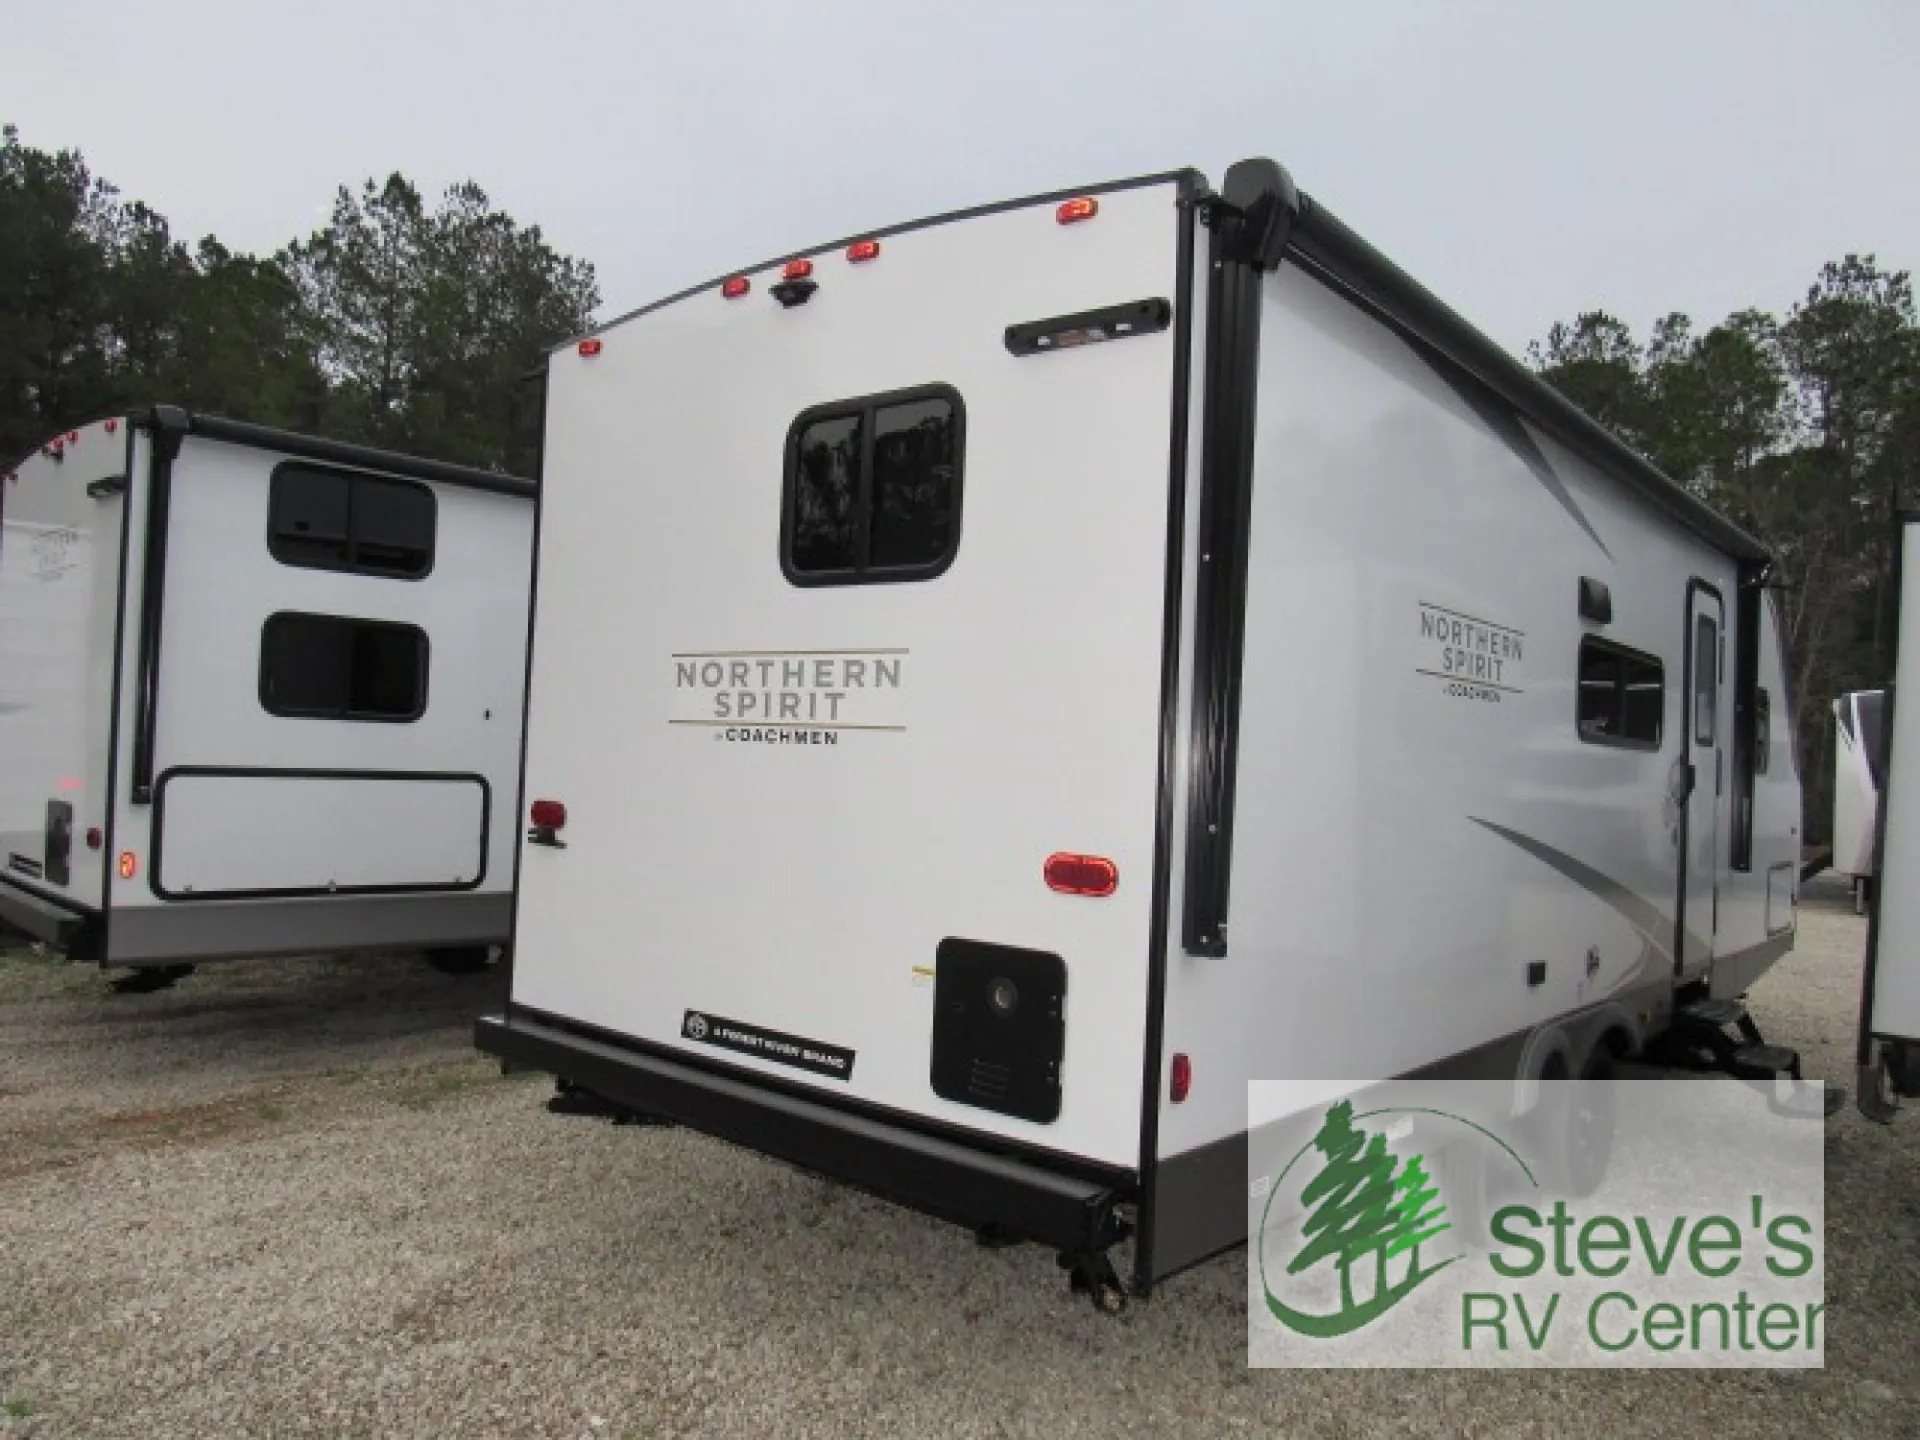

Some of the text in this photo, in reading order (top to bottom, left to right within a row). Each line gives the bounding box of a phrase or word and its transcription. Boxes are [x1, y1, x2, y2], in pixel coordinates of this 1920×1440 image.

[1420, 611, 1523, 661] NORTHERN
[675, 658, 901, 688] NORTHERN
[1442, 646, 1504, 682] SPIRIT
[713, 691, 847, 720] SPIRIT
[724, 727, 838, 745] COACHMEN
